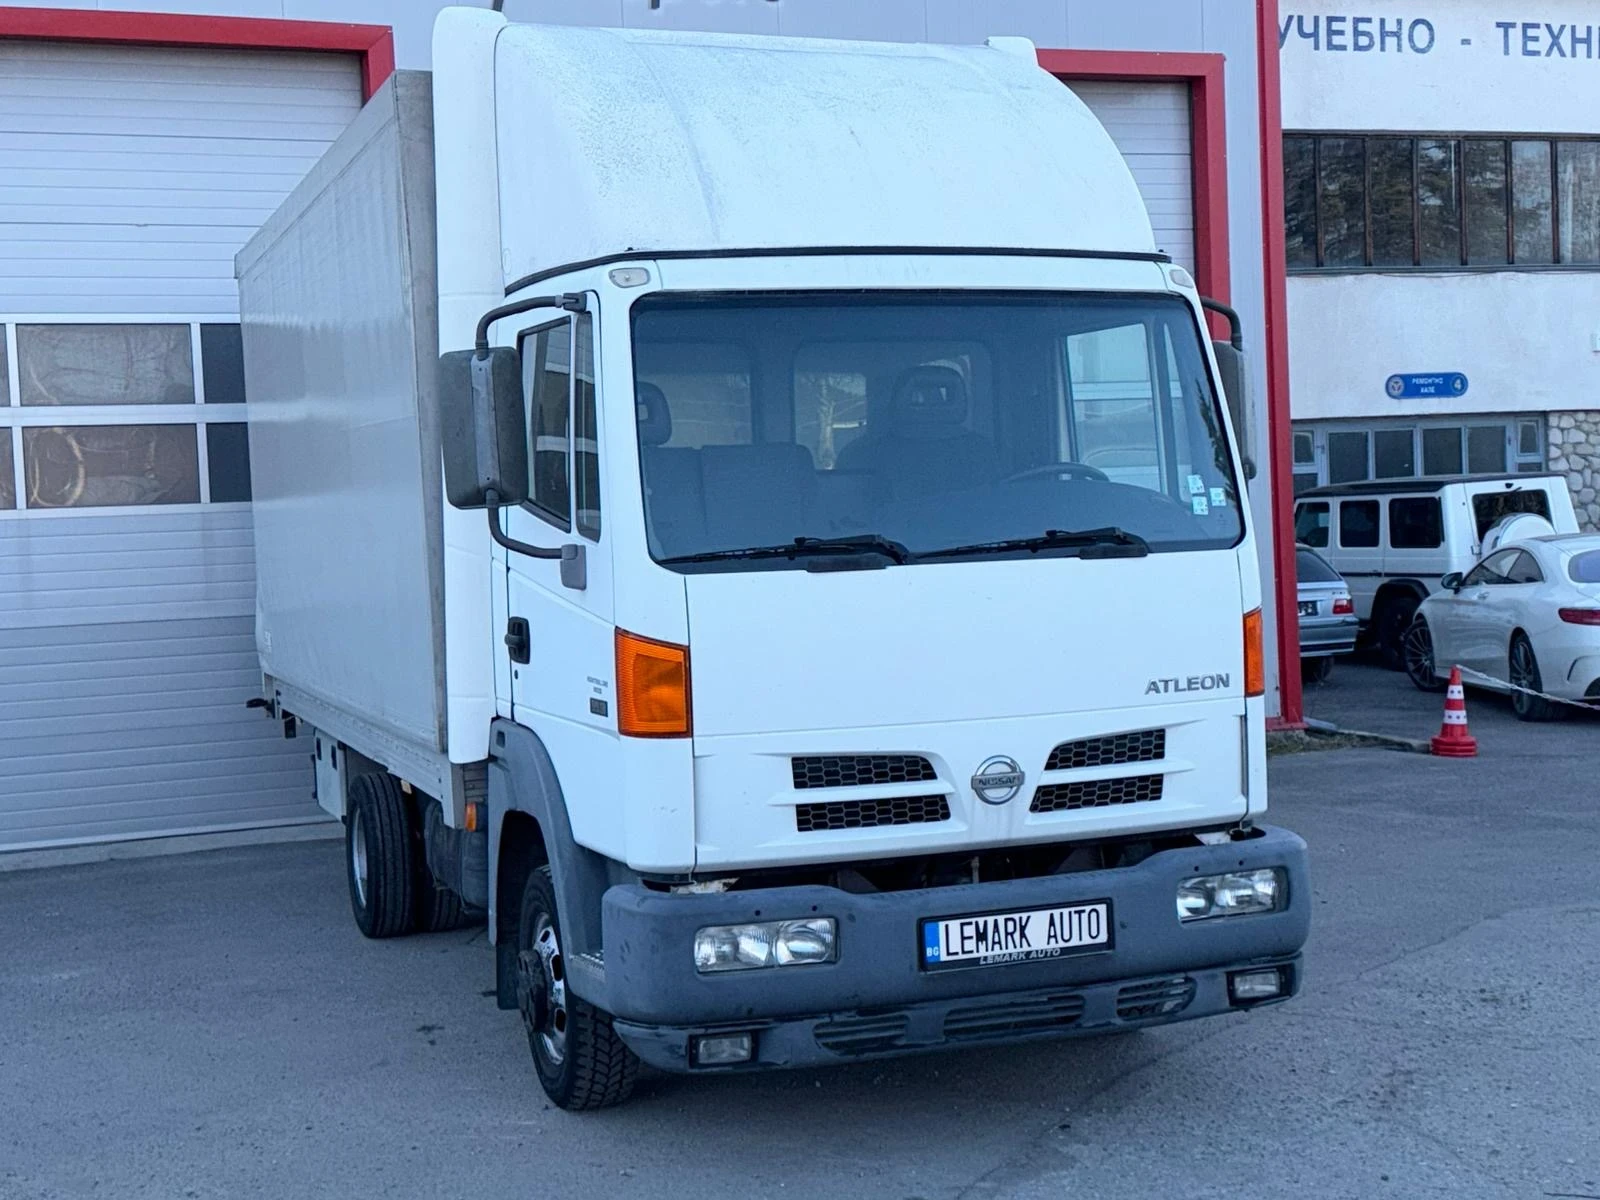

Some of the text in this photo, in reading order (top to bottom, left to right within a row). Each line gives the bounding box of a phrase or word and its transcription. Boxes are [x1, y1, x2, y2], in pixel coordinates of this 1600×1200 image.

[1496, 22, 1600, 59] ТЕХН
[1144, 673, 1230, 695] ATLEON
[945, 908, 1100, 957] LEMARK AUTO
[926, 946, 939, 956] BG
[979, 948, 1061, 965] LEMARK AUTO
